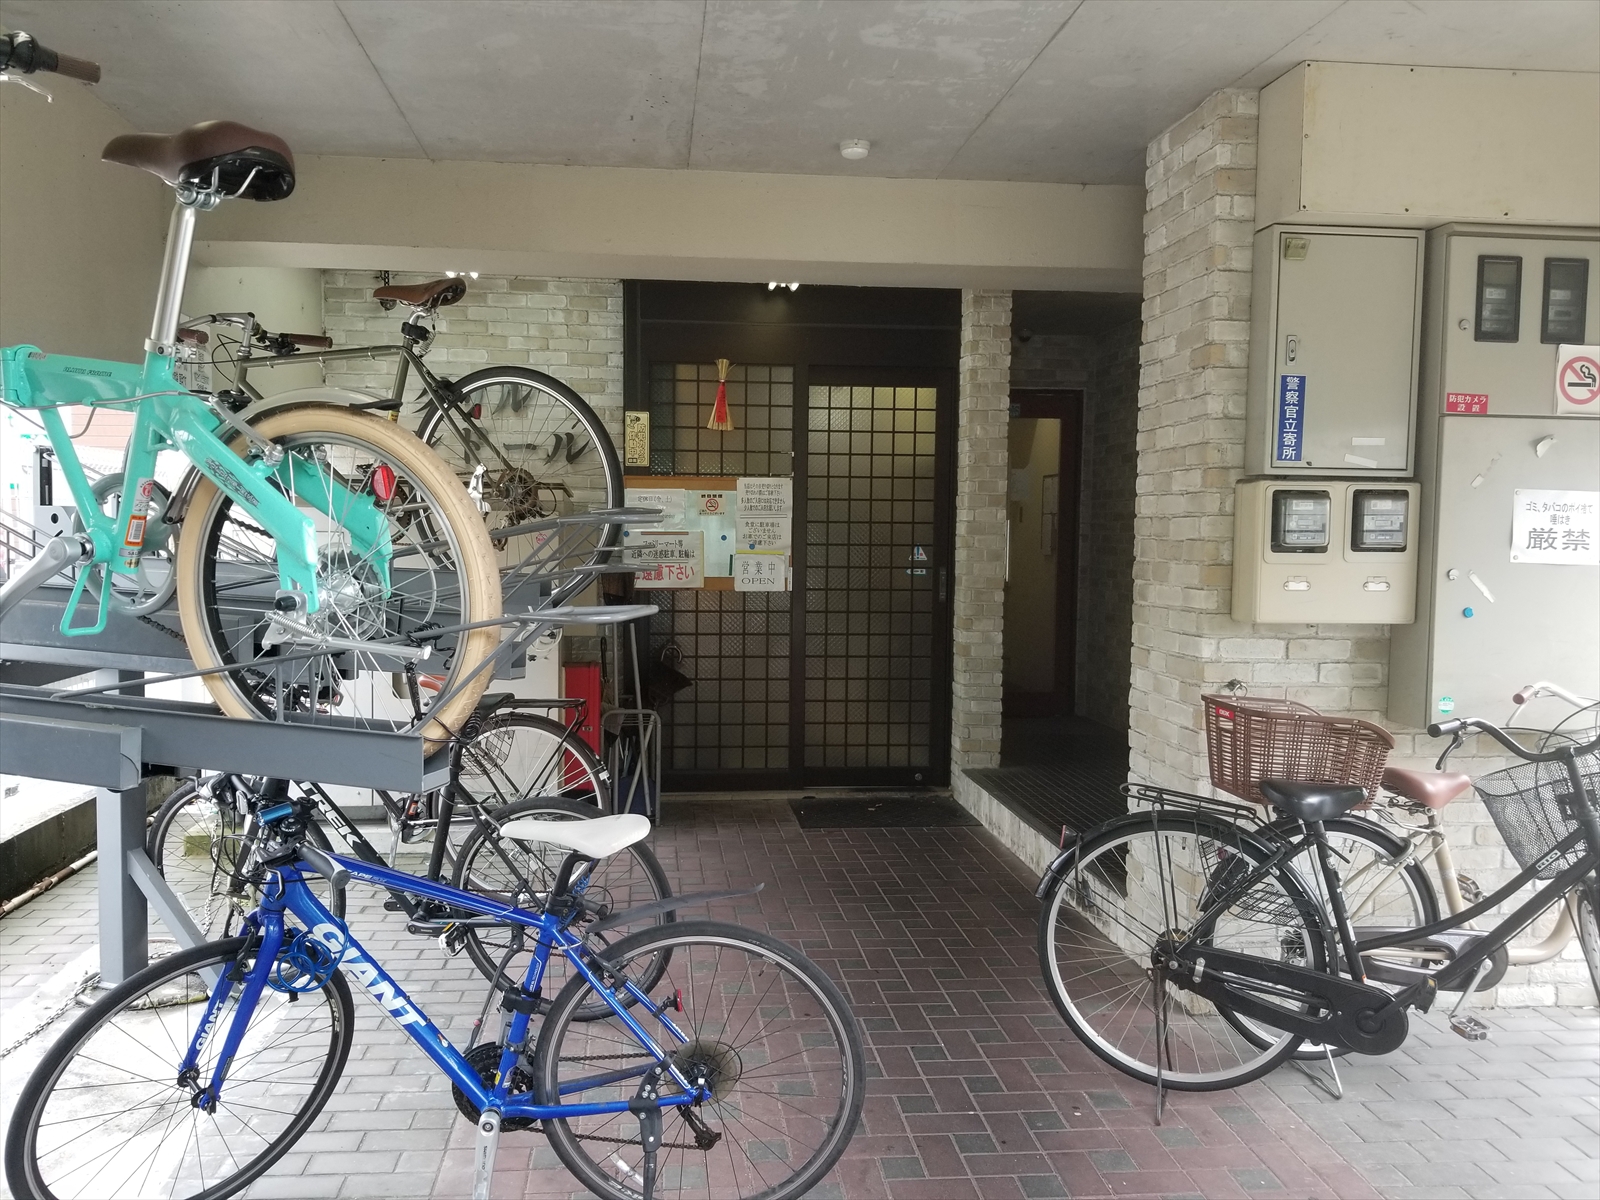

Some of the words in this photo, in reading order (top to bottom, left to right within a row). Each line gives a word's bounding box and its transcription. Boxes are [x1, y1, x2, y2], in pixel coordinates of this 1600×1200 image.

[1448, 394, 1487, 404] 防犯カメラ
[1456, 404, 1481, 413] 設置
[1281, 376, 1301, 461] 警察官立寄所
[637, 423, 646, 463] 防犯カメラ
[1525, 527, 1591, 551] 厳禁
[741, 560, 776, 576] 営業中
[741, 577, 775, 585] OPEN
[299, 781, 362, 848] TREK
[1536, 851, 1560, 870] RIO
[312, 922, 428, 1027] GIANT
[194, 999, 226, 1052] GIANT
